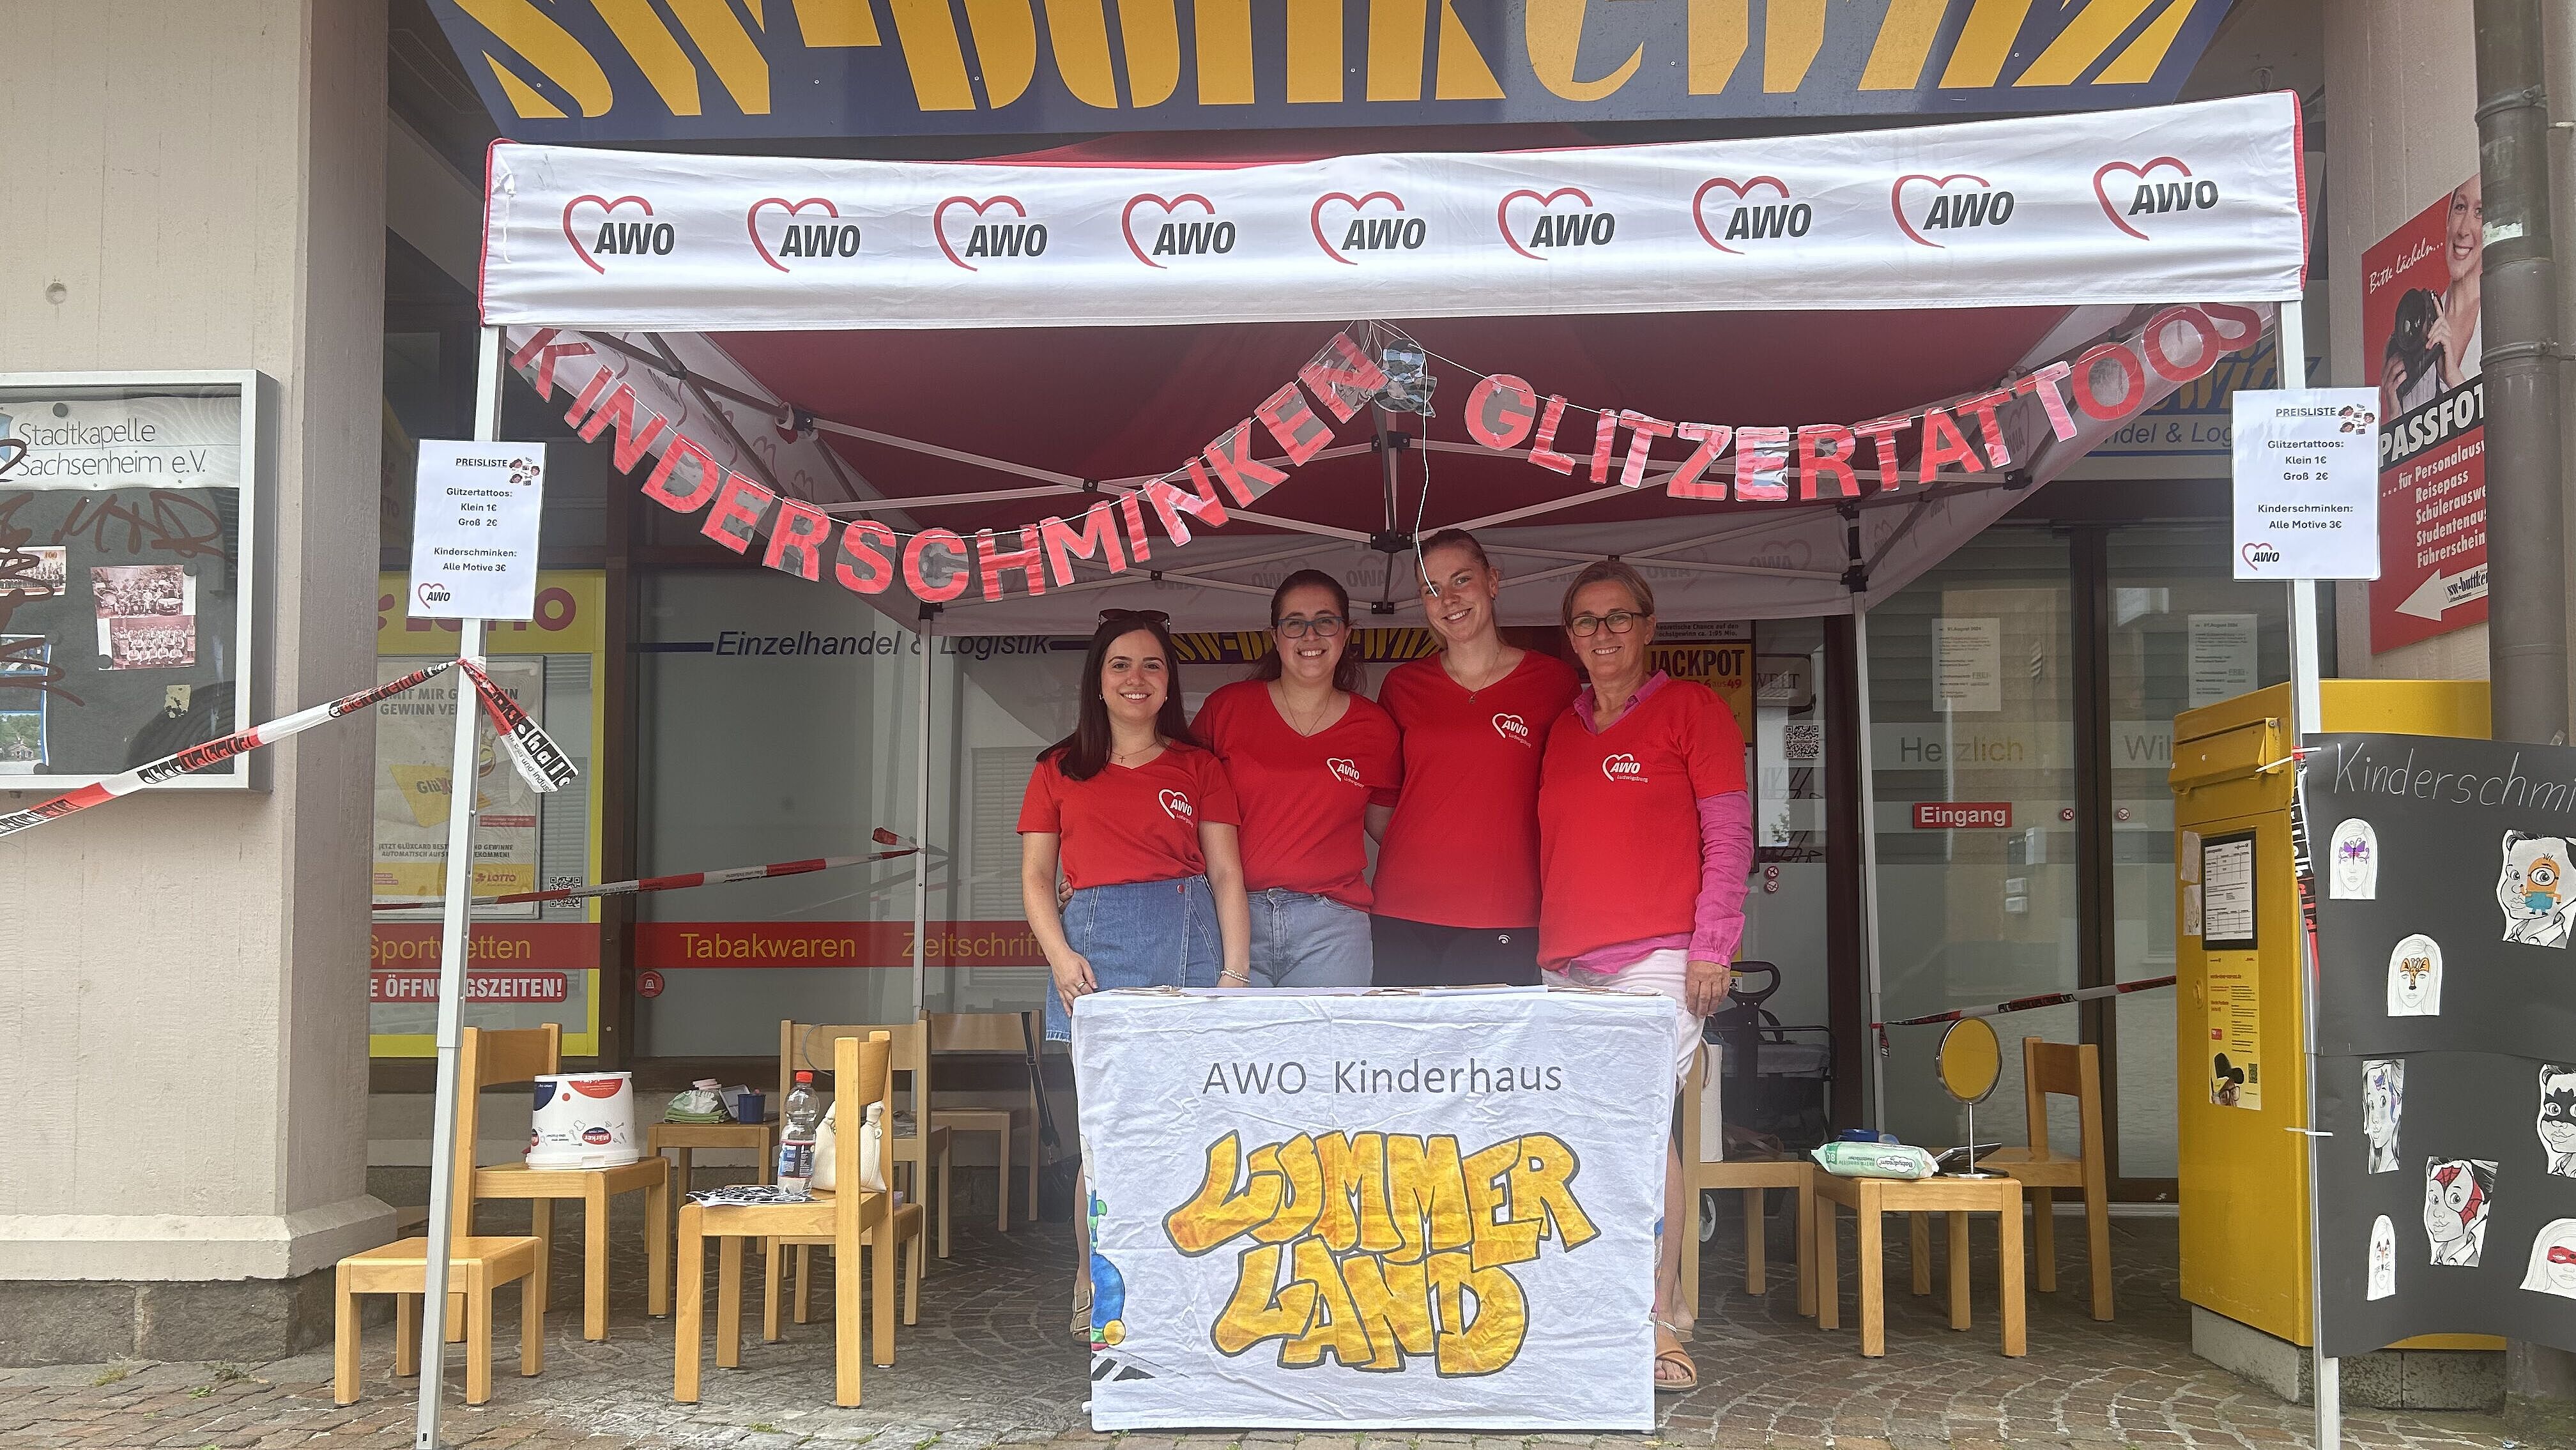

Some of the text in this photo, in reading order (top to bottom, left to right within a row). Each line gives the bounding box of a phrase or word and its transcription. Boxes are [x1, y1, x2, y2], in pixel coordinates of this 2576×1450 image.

[594, 179, 2220, 258] AWO AWO AWO AWO AWO AWO AWO AWO AWO
[2369, 263, 2395, 295] Bitte
[1464, 303, 2262, 501] GLITZERTATTOOS
[2275, 407, 2336, 417] PREISLISTE
[19, 418, 156, 450] Stadtkapelle
[2267, 438, 2345, 449] Glitzertattoos:
[17, 448, 206, 477] Sachsenheim e.V.
[456, 458, 508, 467] PREISLISTE
[509, 328, 1388, 603] KINDERSCHMINKEN
[2285, 455, 2327, 466] Klein 1€
[2283, 471, 2329, 481] Groß 2€
[447, 488, 513, 498] Glitzertattoos:
[2415, 470, 2469, 503] Reisepass
[461, 503, 497, 512] Klein 1€
[2257, 503, 2354, 514] Kinderschminken:
[458, 518, 498, 527] Groß 2€
[2269, 519, 2343, 530] Alle Motive 3€
[434, 547, 518, 557] Kinderschminken:
[2252, 551, 2280, 563] AWO
[443, 563, 507, 572] Alle Motive 3€
[426, 591, 451, 602] AWO
[716, 631, 899, 655] Einzelhandel
[940, 635, 1048, 660] Logistik
[1650, 649, 1745, 677] JACKPOT
[418, 689, 445, 700] MIR
[380, 704, 435, 715] GEWINN
[1501, 721, 1528, 736] AWO
[1337, 763, 1360, 780] AWO
[1610, 763, 1641, 774] AWO
[2334, 742, 2576, 814] Kinderschmi
[1170, 798, 1192, 816] AWO
[1920, 806, 2007, 826] Eingang
[487, 873, 516, 882] LOTTO
[680, 933, 855, 958] Tabakwaren
[1203, 1059, 1563, 1094] AWO Kinderhaus
[1162, 1130, 1601, 1271] LUMMER
[1211, 1235, 1529, 1378] LAND
